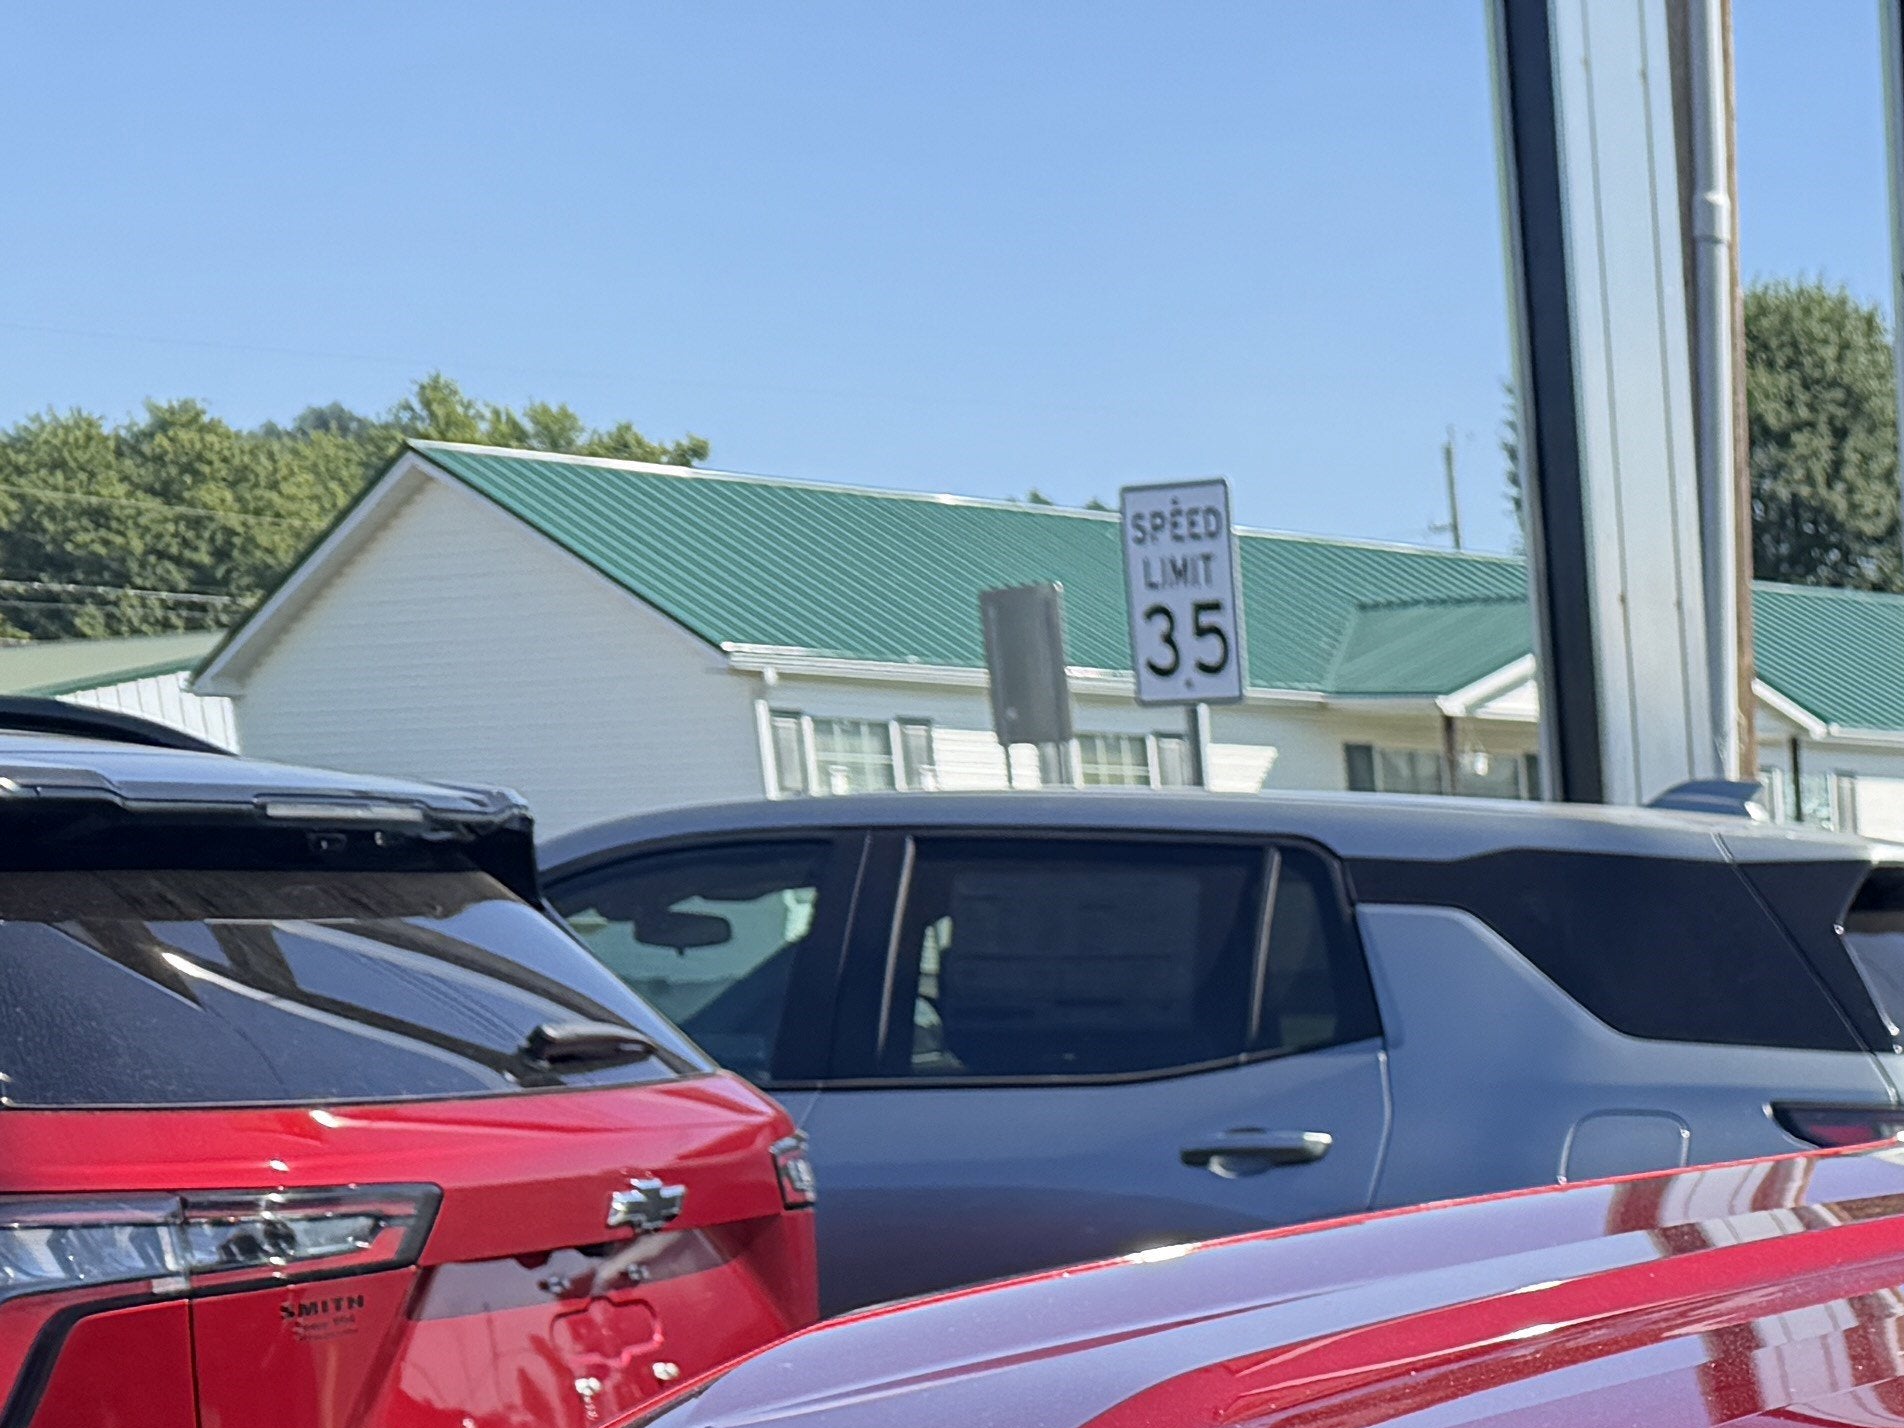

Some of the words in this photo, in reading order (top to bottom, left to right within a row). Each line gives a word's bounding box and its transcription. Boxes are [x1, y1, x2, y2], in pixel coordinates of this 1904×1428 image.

[1131, 505, 1223, 545] SPEED
[1142, 552, 1214, 590] LIMIT
[1144, 600, 1229, 677] 35
[280, 1294, 364, 1320] SMITH
